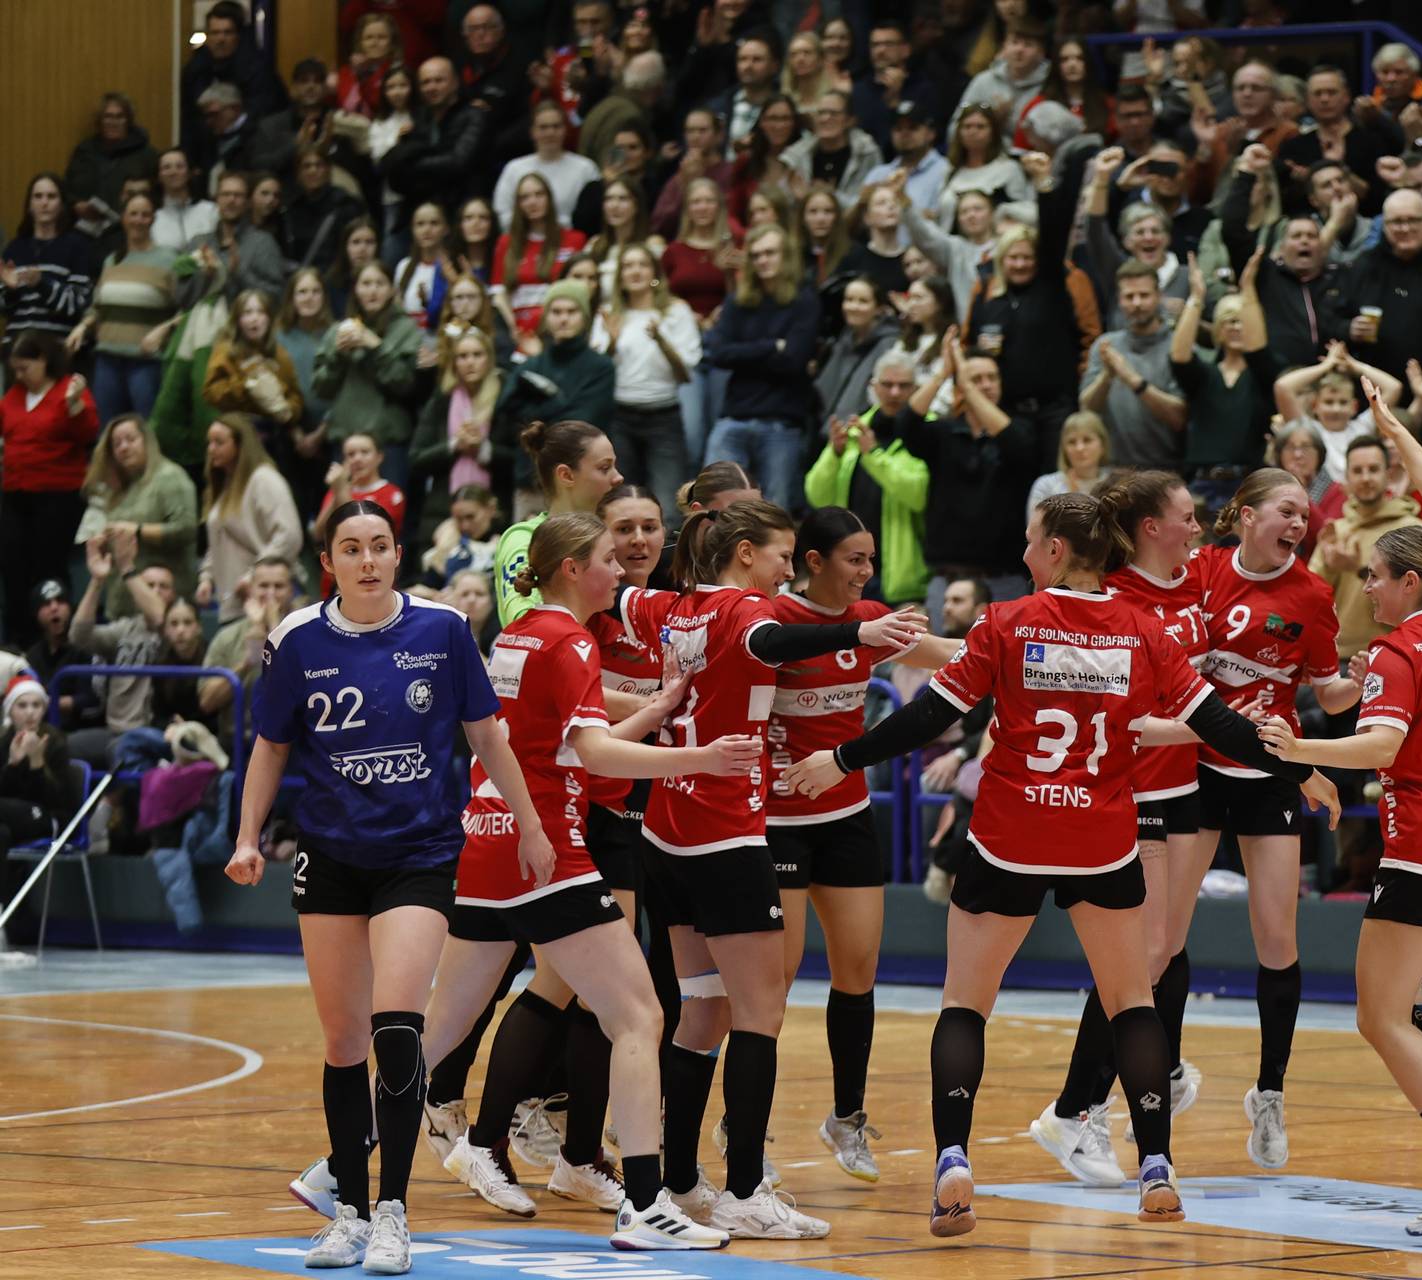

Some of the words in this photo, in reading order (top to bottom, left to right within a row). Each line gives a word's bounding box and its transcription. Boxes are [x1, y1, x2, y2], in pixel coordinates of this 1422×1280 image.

[1226, 604, 1251, 641] 9
[1015, 626, 1036, 638] HSV
[1038, 628, 1088, 646] SOLINGEN
[402, 660, 434, 670] boeken
[407, 652, 448, 663] druckhaus
[304, 667, 340, 680] Kempa
[1024, 668, 1067, 682] Brangs
[1078, 671, 1128, 685] Heinrich
[824, 690, 866, 703] WÜST
[307, 686, 367, 733] 22
[1027, 708, 1108, 776] 31
[1024, 784, 1092, 809] STENS
[623, 810, 644, 821] CKER
[294, 851, 309, 882] 2
[774, 863, 798, 872] CKER
